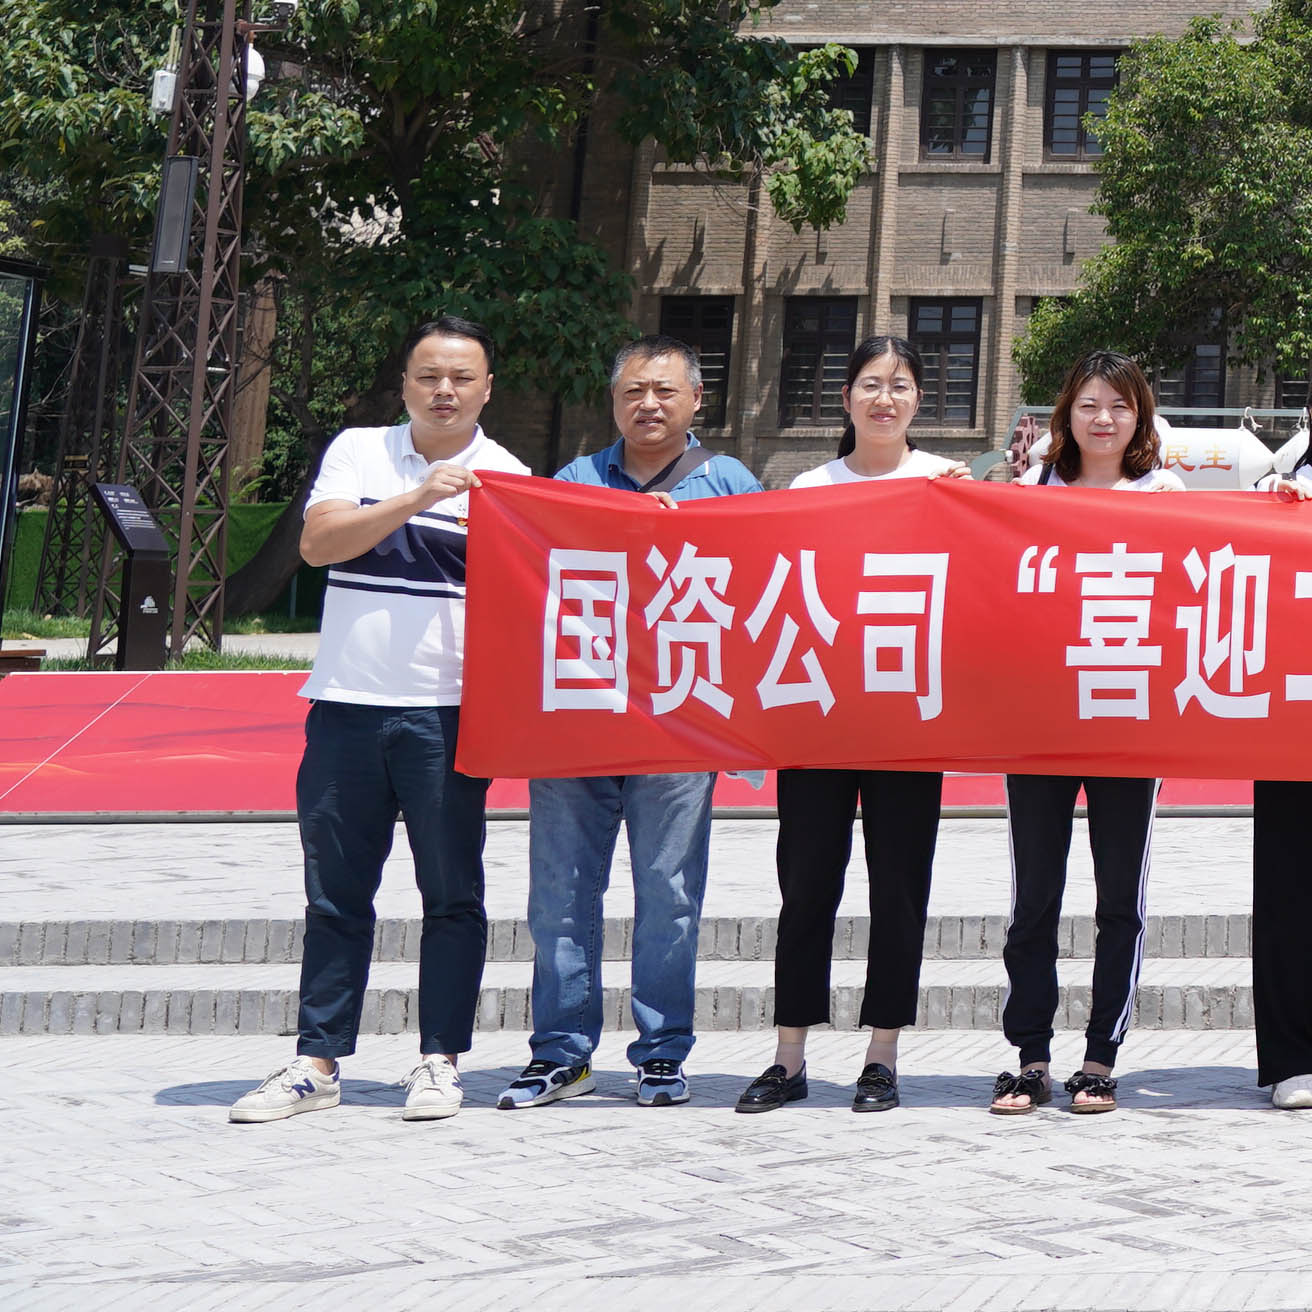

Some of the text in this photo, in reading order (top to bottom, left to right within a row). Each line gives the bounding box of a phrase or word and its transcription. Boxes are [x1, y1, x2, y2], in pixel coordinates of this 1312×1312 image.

[1163, 442, 1233, 472] 民主
[543, 541, 949, 721] 国资公司
